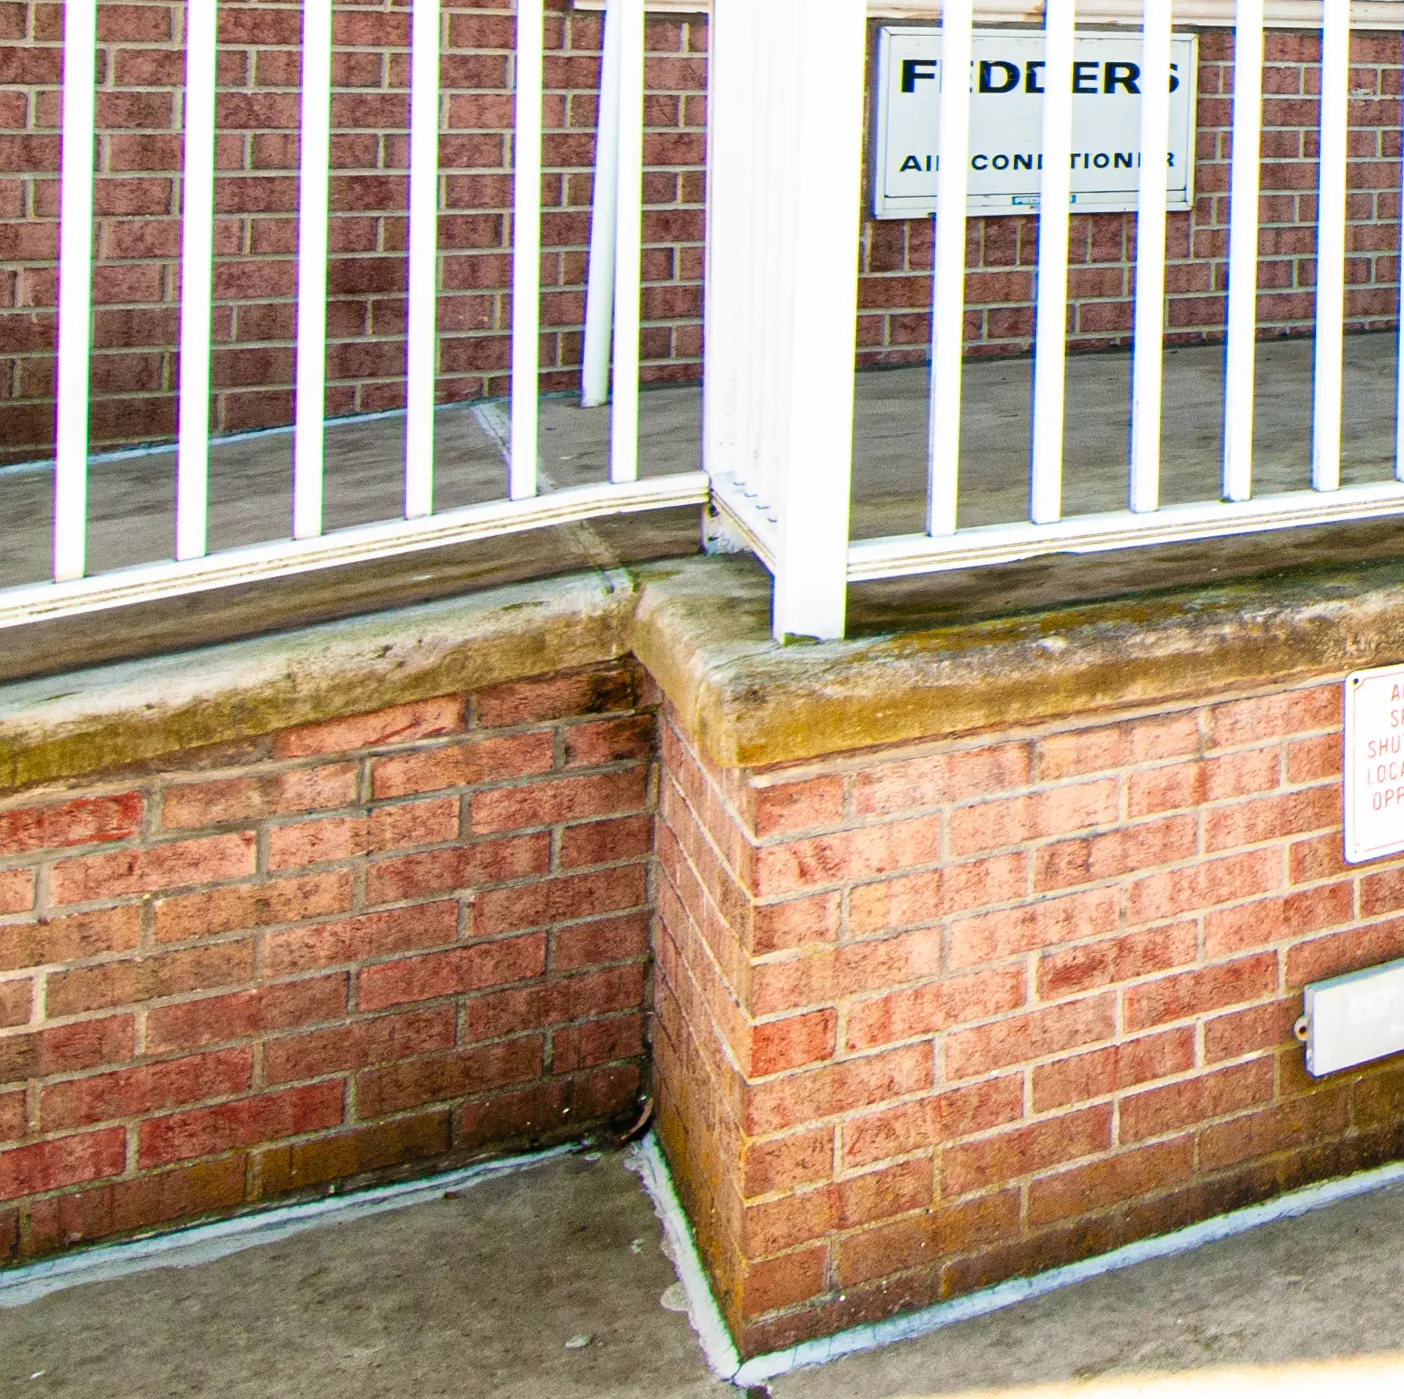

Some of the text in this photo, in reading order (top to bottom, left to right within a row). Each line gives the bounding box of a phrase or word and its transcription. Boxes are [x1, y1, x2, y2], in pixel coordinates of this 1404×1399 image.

[900, 59, 1180, 94] FDER
[899, 151, 1175, 172] AI CONTION
